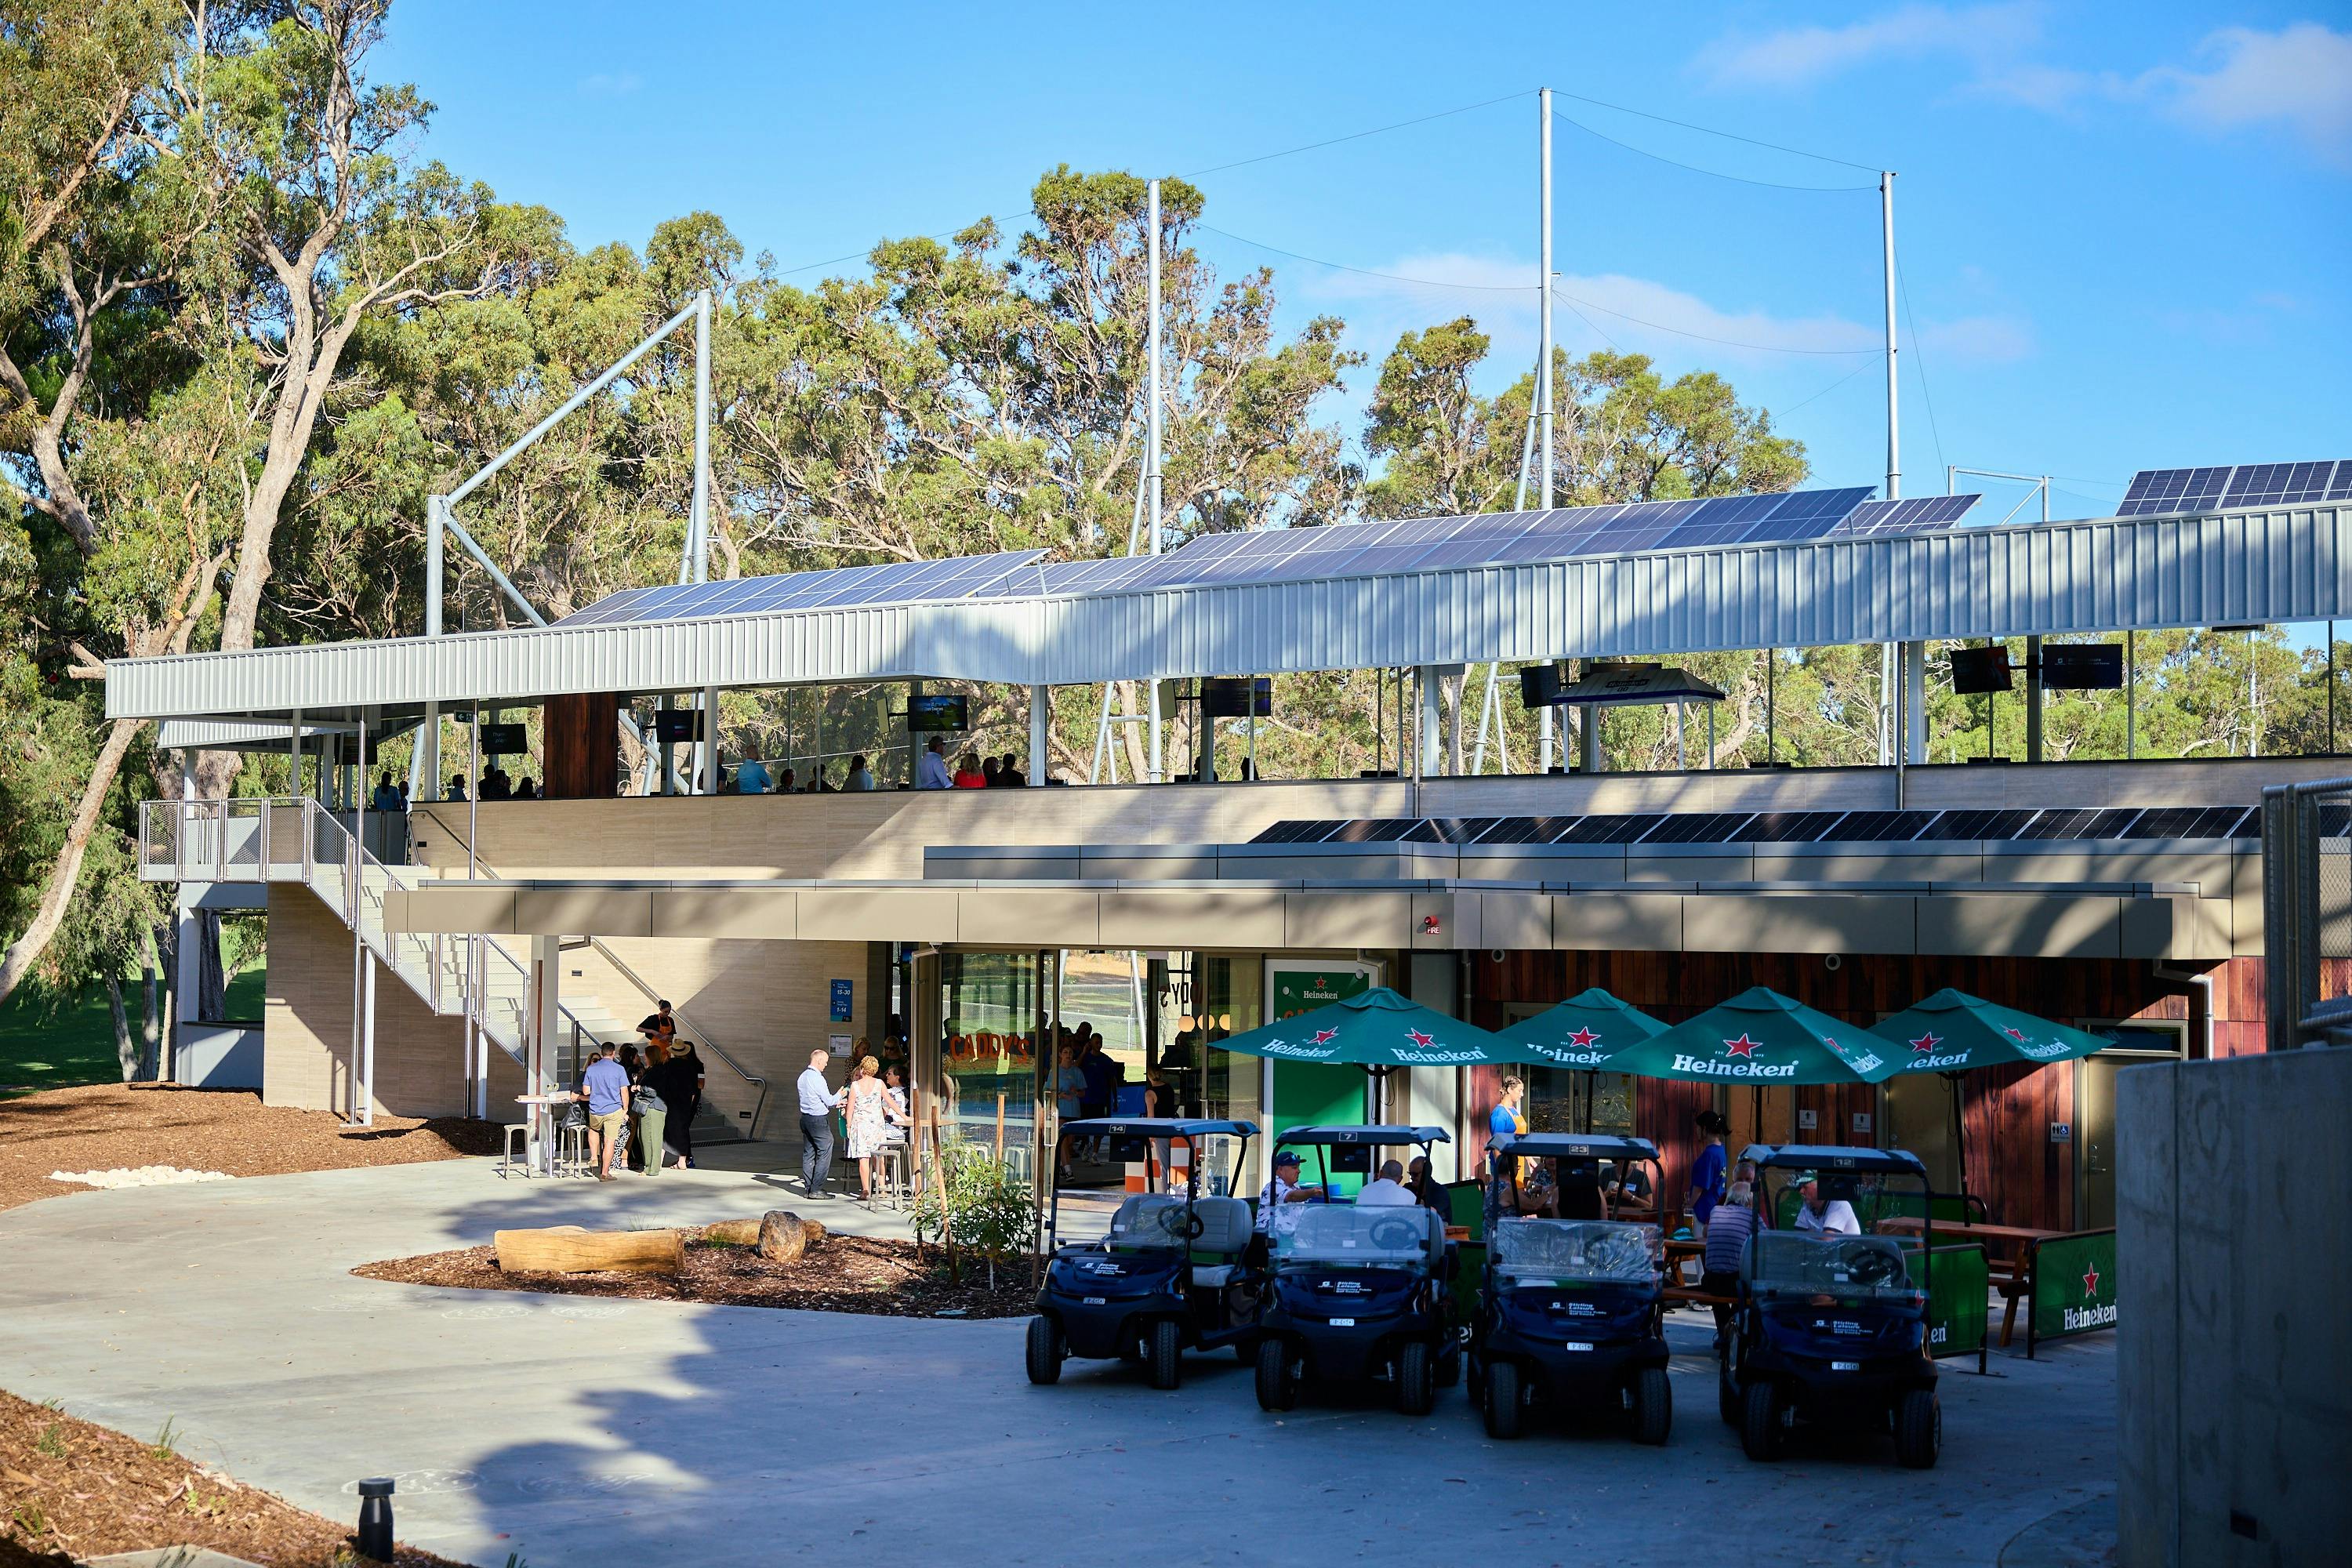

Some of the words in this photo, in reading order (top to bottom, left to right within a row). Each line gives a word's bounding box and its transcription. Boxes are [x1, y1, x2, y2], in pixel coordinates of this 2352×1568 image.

[1303, 990, 1338, 1000] Heineken
[949, 1033, 1029, 1064] CADDY'S
[1261, 1039, 1335, 1058] Heineken
[1390, 1047, 1488, 1062] Heineken
[1671, 1054, 1795, 1076] Heineken
[2064, 1303, 2118, 1330] Heineken
